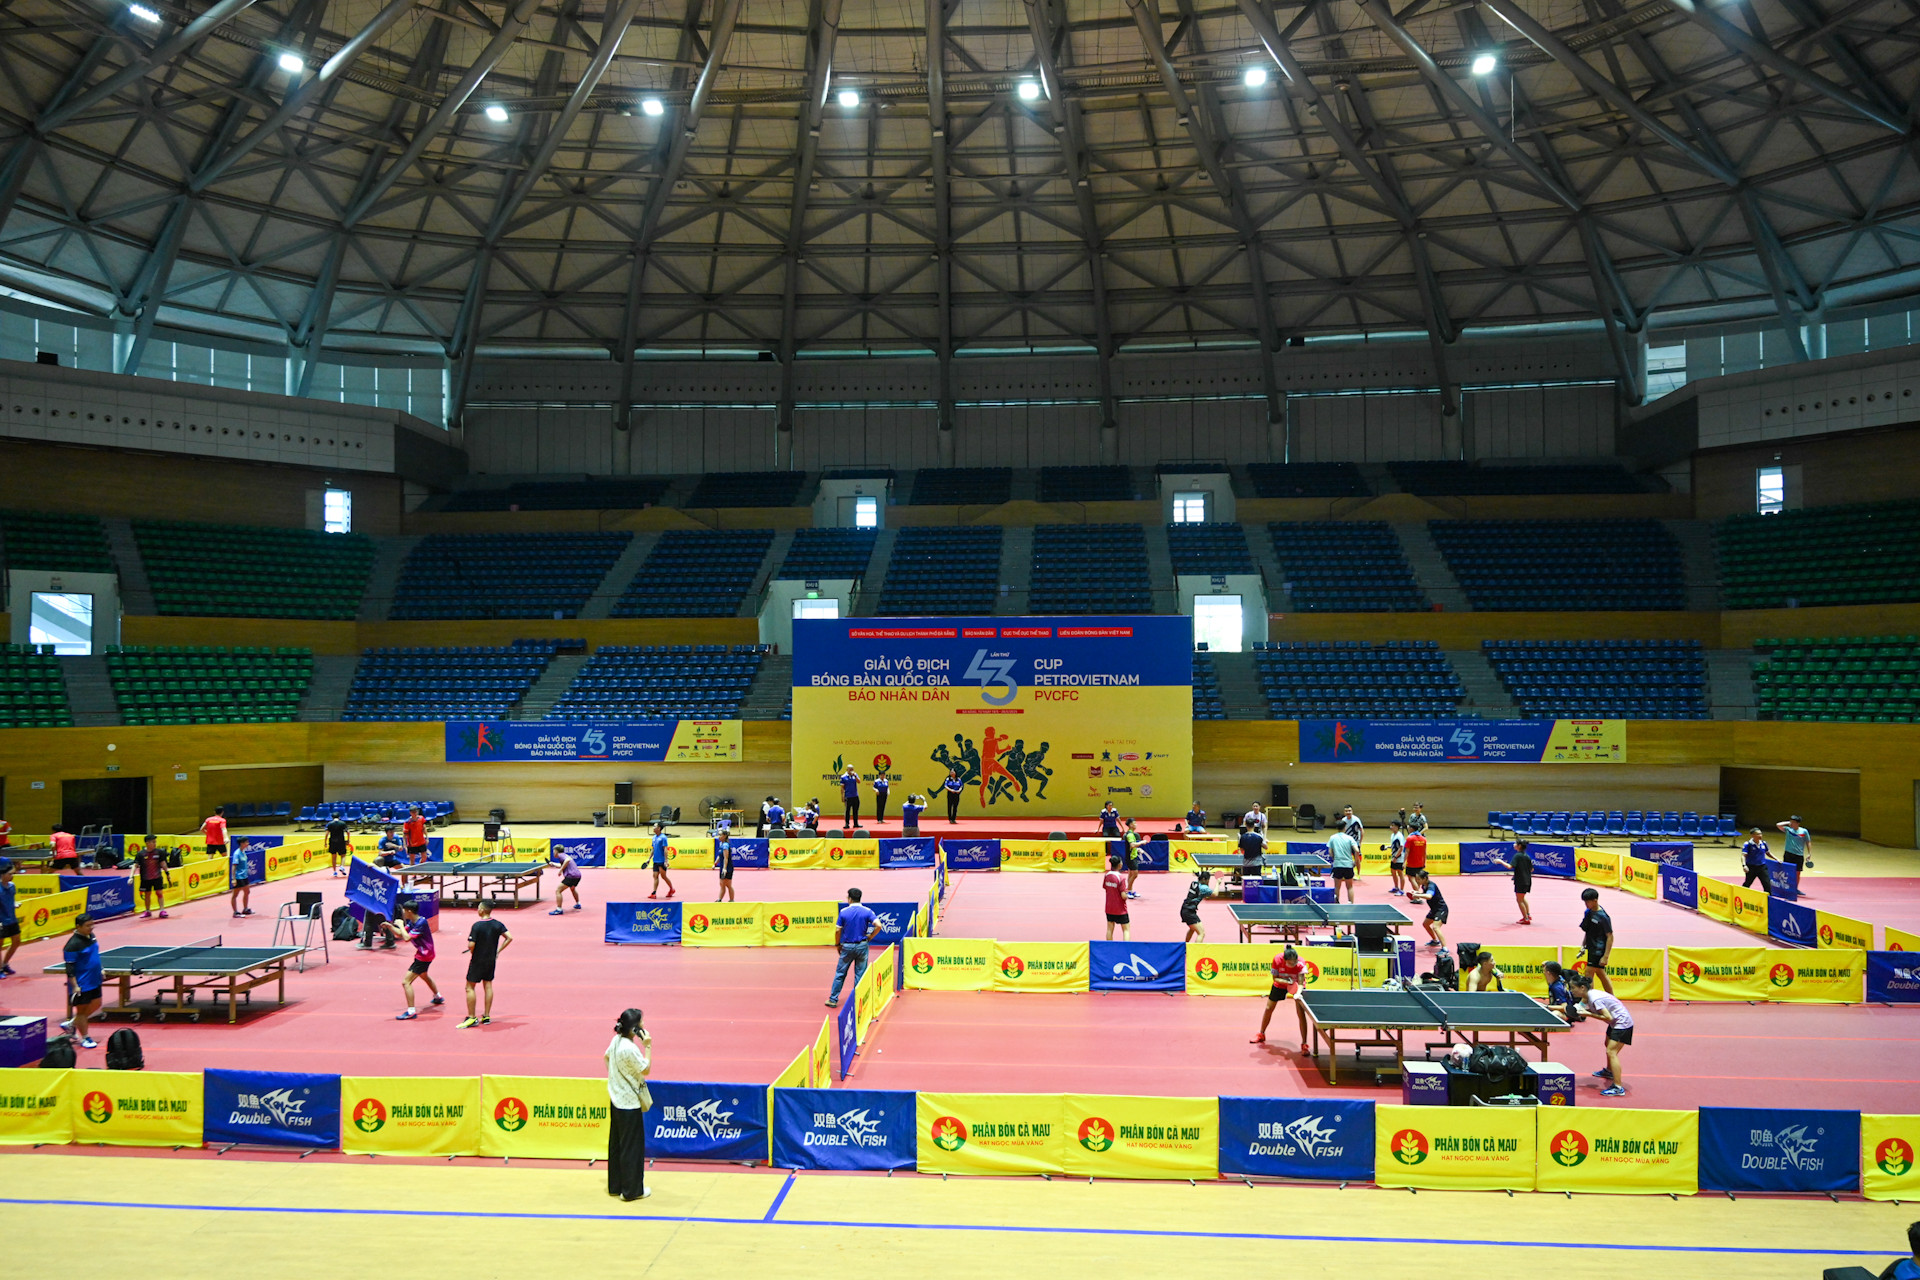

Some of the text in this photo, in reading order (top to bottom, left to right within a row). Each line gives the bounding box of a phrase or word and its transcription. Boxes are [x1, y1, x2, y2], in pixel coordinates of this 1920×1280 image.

[864, 655, 950, 673] GIẢI VÔ ĐỊCH
[1034, 659, 1062, 670] CUP
[812, 670, 950, 686] BÓNG BÀN QUỐC GIA
[963, 649, 1017, 706] 43
[1035, 674, 1139, 685] PETROVIETNAM
[849, 688, 950, 700] BÁO NHÂN DÂN
[1035, 690, 1079, 700] PVCFC
[632, 924, 654, 932] DOUBLE
[937, 955, 986, 965] PHÂN BÓN CÀ MAU
[1222, 961, 1237, 971] PHÂN
[1239, 962, 1250, 971] BÓN
[1252, 961, 1259, 971] CÀ
[1704, 965, 1755, 975] PHÂN BÓN CÀ MAU
[1887, 981, 1920, 989] Double
[118, 1097, 187, 1112] PHÂN BÓN CÀ MAU
[1552, 1096, 1564, 1104] 27
[392, 1104, 464, 1118] PHÂN BÓN CÀ MAU
[534, 1104, 606, 1119] PHÂN BÓN CÀ MAU
[229, 1111, 312, 1126] Double FISH
[654, 1125, 741, 1138] Double FISH
[972, 1122, 1050, 1137] PHÂN BÓN CÀ MAU
[1120, 1124, 1200, 1140] PHÂN BÓN CÀ MAU
[804, 1132, 887, 1146] DOUBLE FISH
[1435, 1136, 1517, 1151] PHÂN BÓN CÀ MAU
[1595, 1137, 1678, 1154] PHÂN BÓN CÀ MAU
[1249, 1142, 1343, 1157] Double FISH
[1742, 1154, 1824, 1170] DOUBLE FISH
